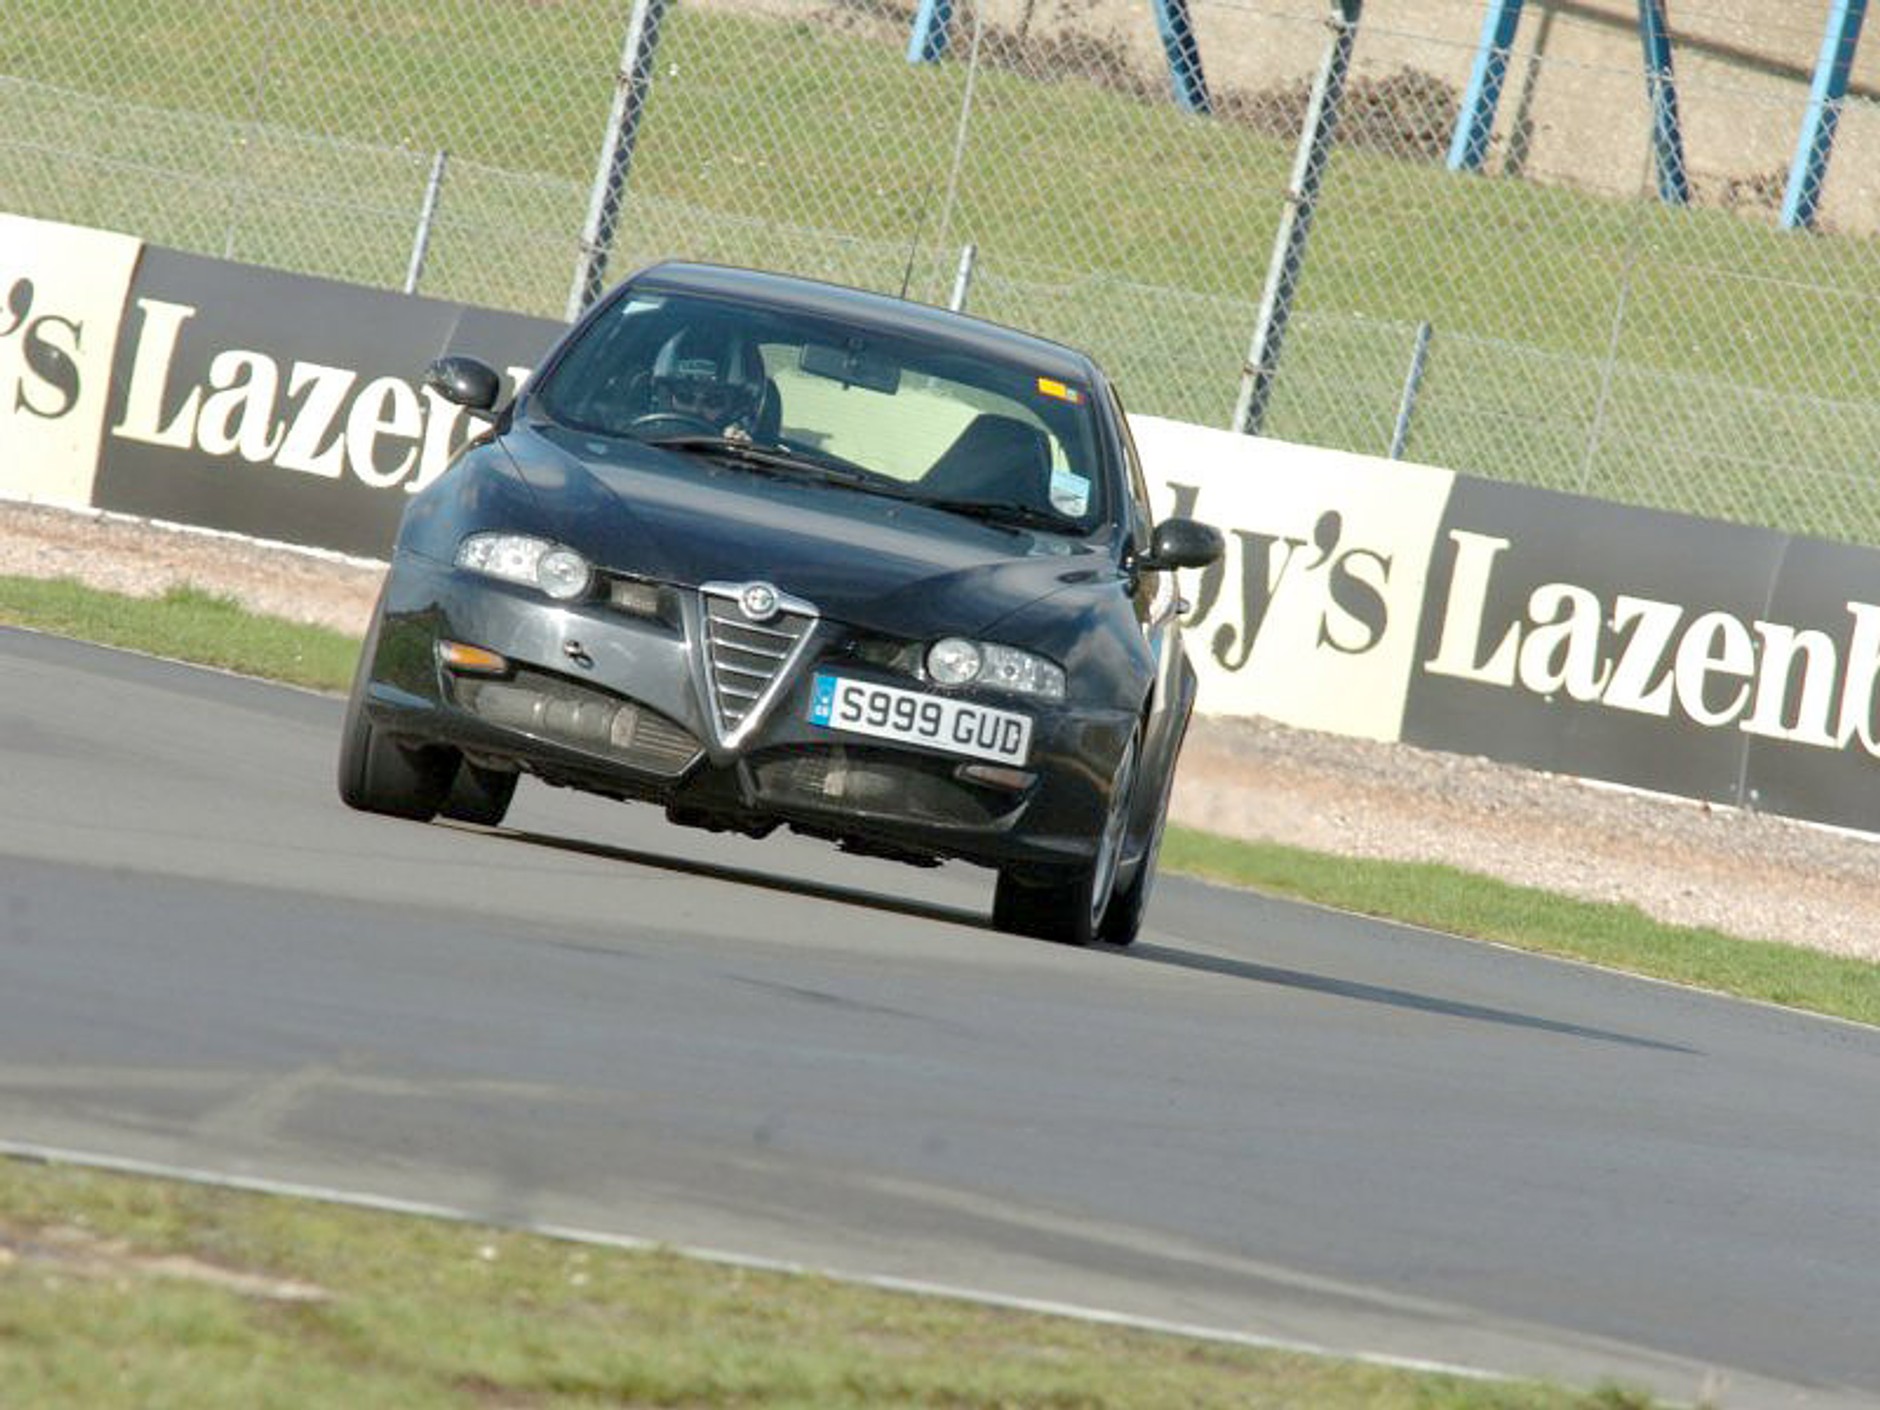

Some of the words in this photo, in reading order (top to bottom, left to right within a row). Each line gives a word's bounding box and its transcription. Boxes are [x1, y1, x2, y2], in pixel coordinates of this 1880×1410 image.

[112, 297, 533, 494] Lazen
[839, 686, 943, 738] S999
[952, 709, 1023, 756] GUD
